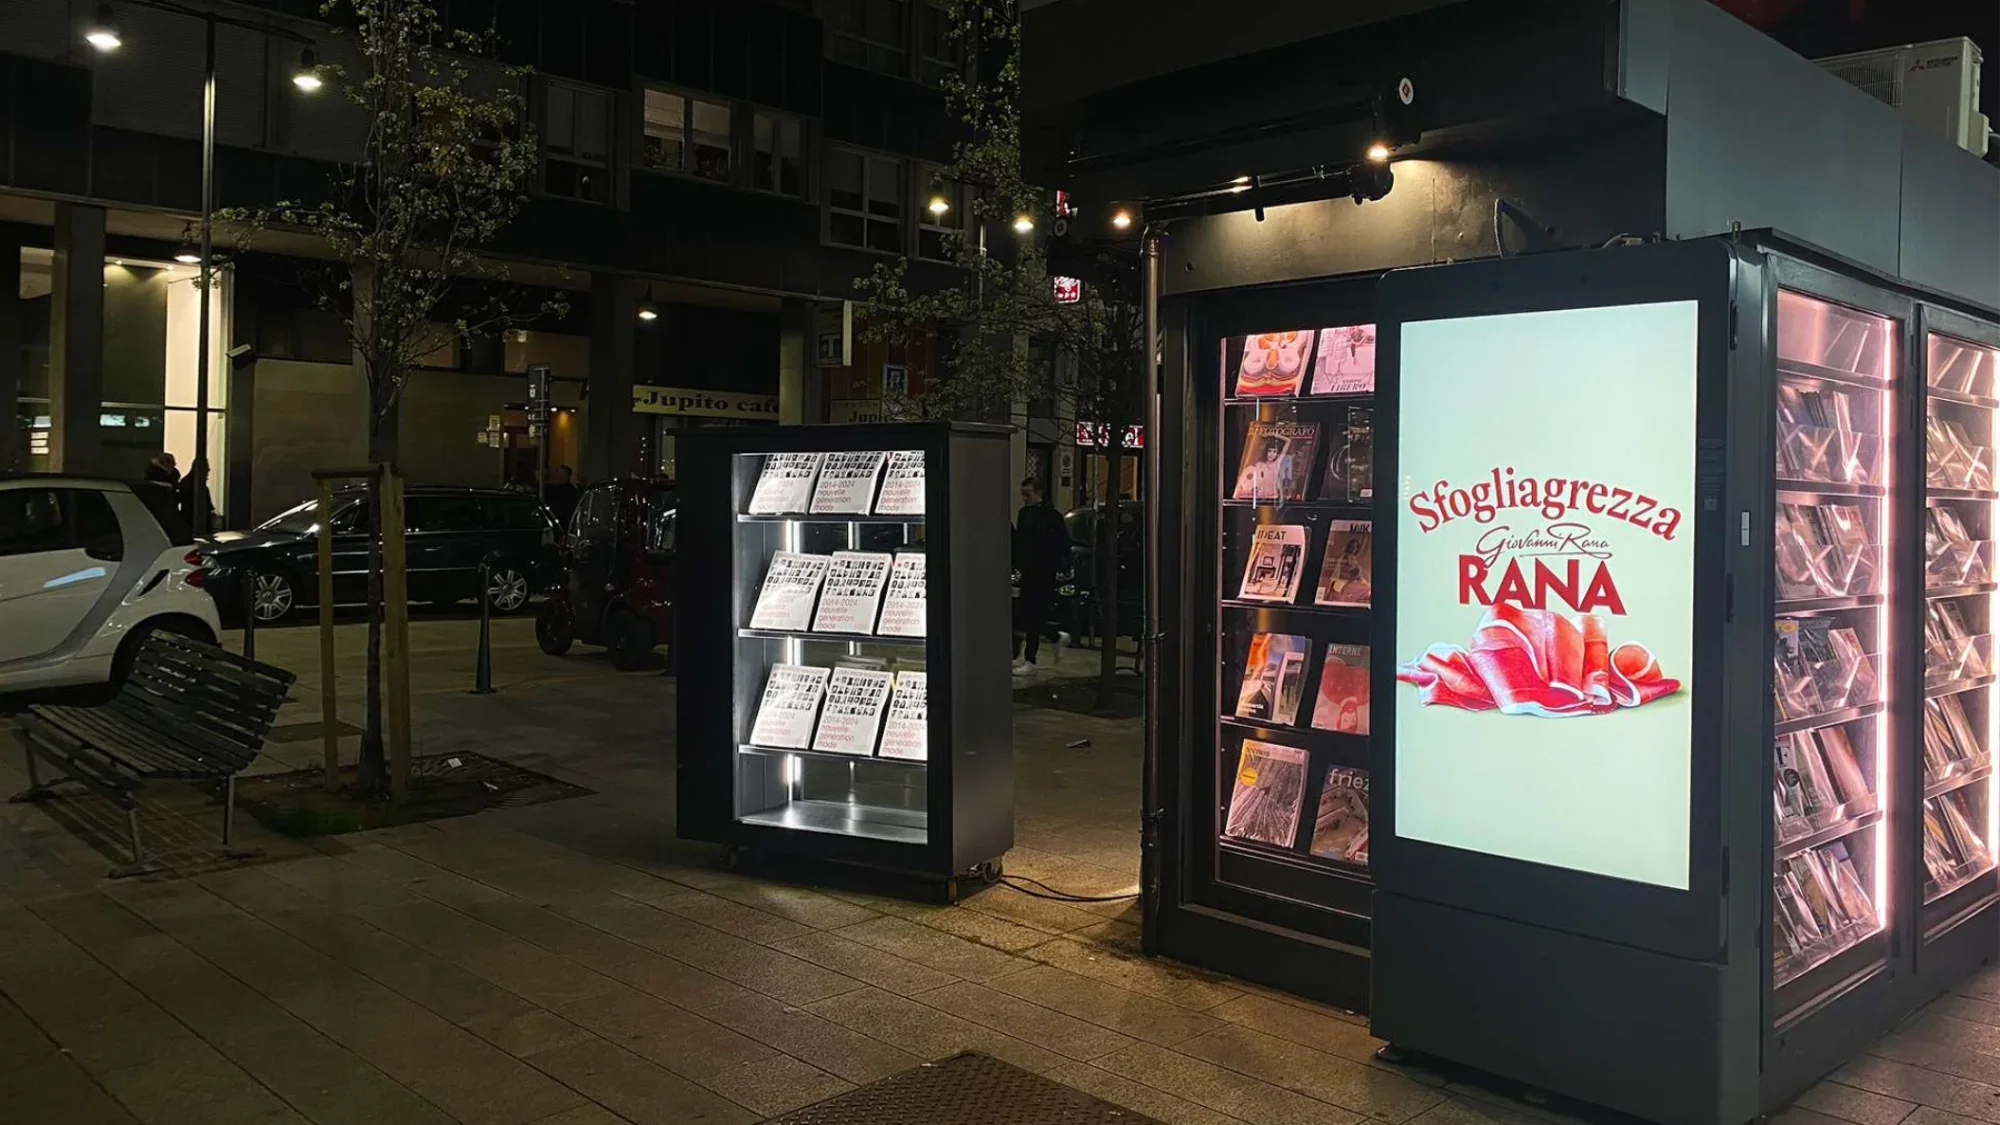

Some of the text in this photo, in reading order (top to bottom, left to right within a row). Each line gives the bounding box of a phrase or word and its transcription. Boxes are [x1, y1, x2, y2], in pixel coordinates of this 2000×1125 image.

[643, 391, 728, 412] Jupito
[1409, 466, 1682, 541] Sfogliagrezza
[1476, 522, 1612, 569] Giovanni Rana
[1458, 554, 1627, 615] RANA
